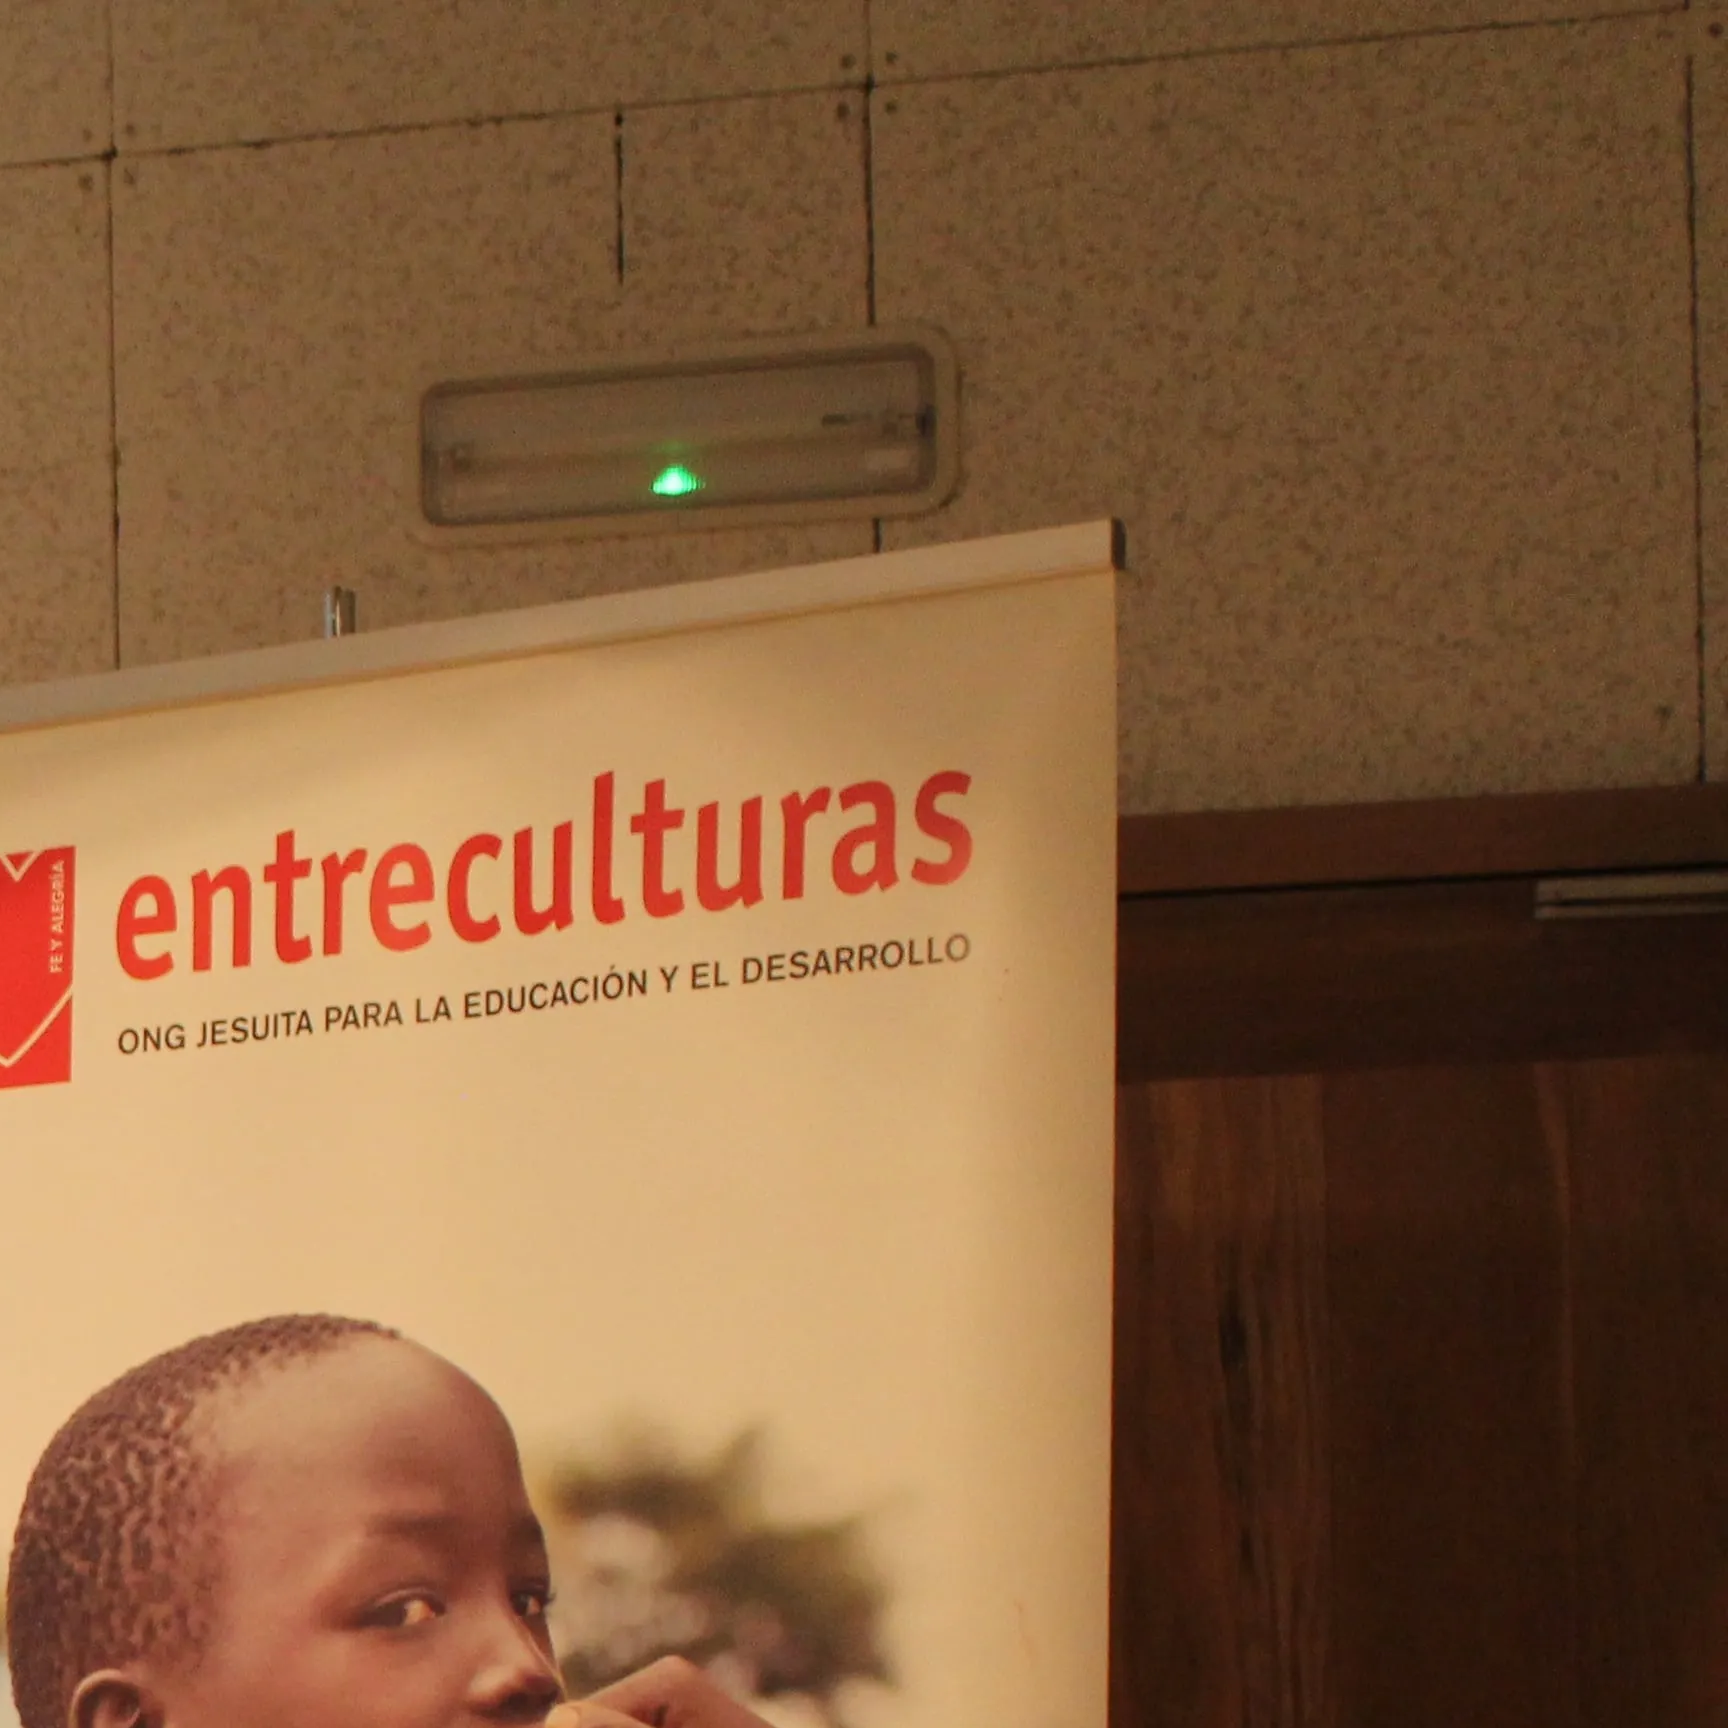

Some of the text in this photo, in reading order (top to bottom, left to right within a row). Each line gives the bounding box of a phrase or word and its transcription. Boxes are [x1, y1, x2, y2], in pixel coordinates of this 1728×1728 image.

[116, 769, 973, 980] entreculturas
[49, 953, 64, 973] FE
[117, 932, 971, 1054] ONG JESUITA PARA LA EDUCACIÓN Y EL DESARROLLO
